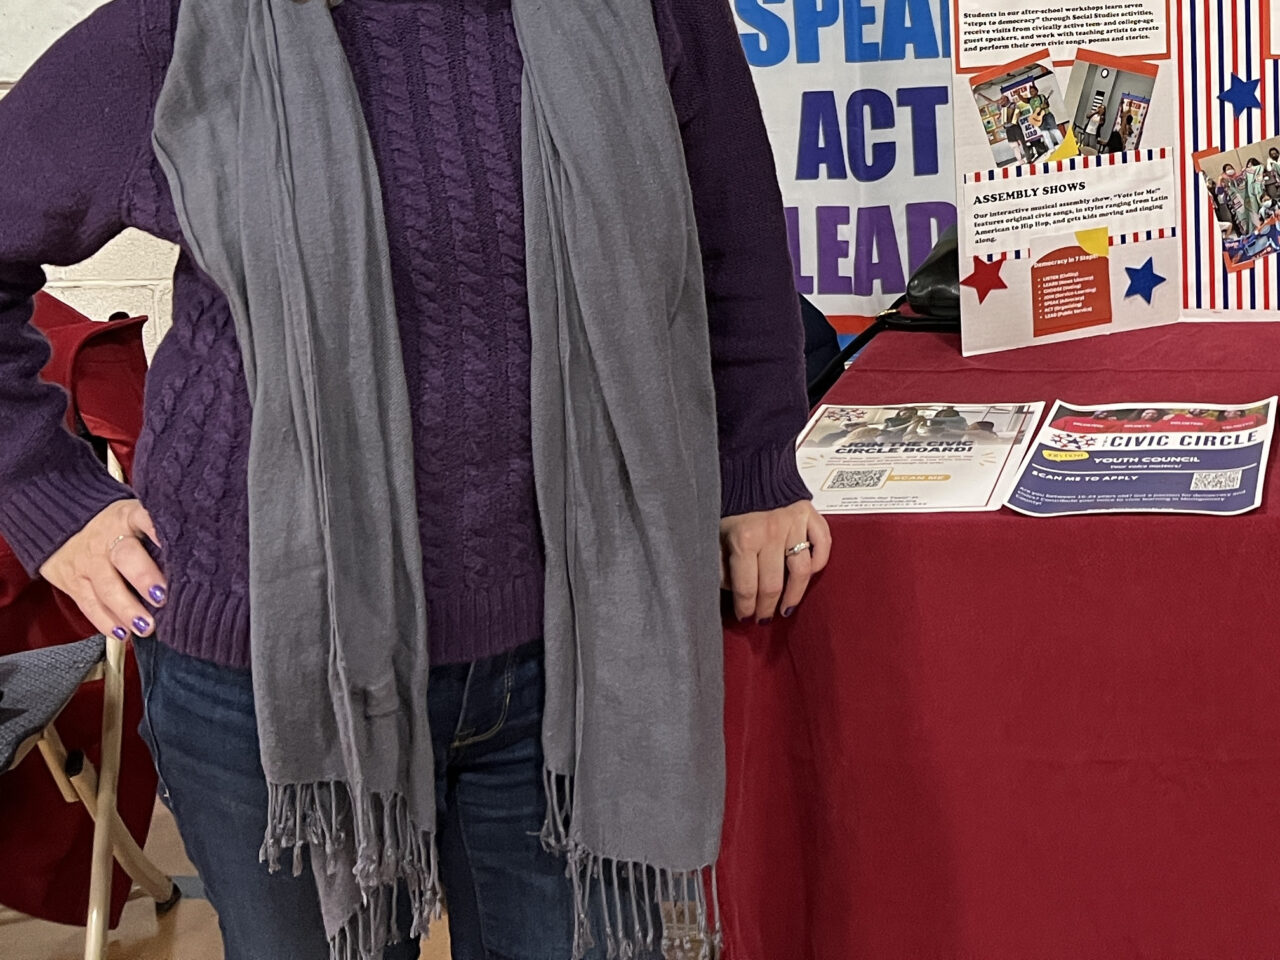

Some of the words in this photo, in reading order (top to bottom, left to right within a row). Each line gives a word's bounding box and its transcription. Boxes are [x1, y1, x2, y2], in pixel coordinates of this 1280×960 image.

[1020, 6, 1063, 15] after-school
[1041, 14, 1071, 22] through
[1071, 12, 1092, 20] Social
[1120, 9, 1153, 17] activities,
[1031, 23, 1062, 31] civically
[963, 36, 983, 44] guest
[984, 35, 1019, 43] speakers,
[1074, 28, 1104, 36] teaching
[963, 44, 978, 52] and
[978, 43, 1009, 52] perform
[795, 86, 949, 182] ACT
[972, 186, 1039, 205] ASSEMBLY
[1041, 181, 1086, 195] SHOWS
[888, 440, 924, 448] THE
[1110, 435, 1170, 447] CIVIC
[1179, 430, 1258, 446] CIRCLE
[1032, 470, 1062, 480] SCAN
